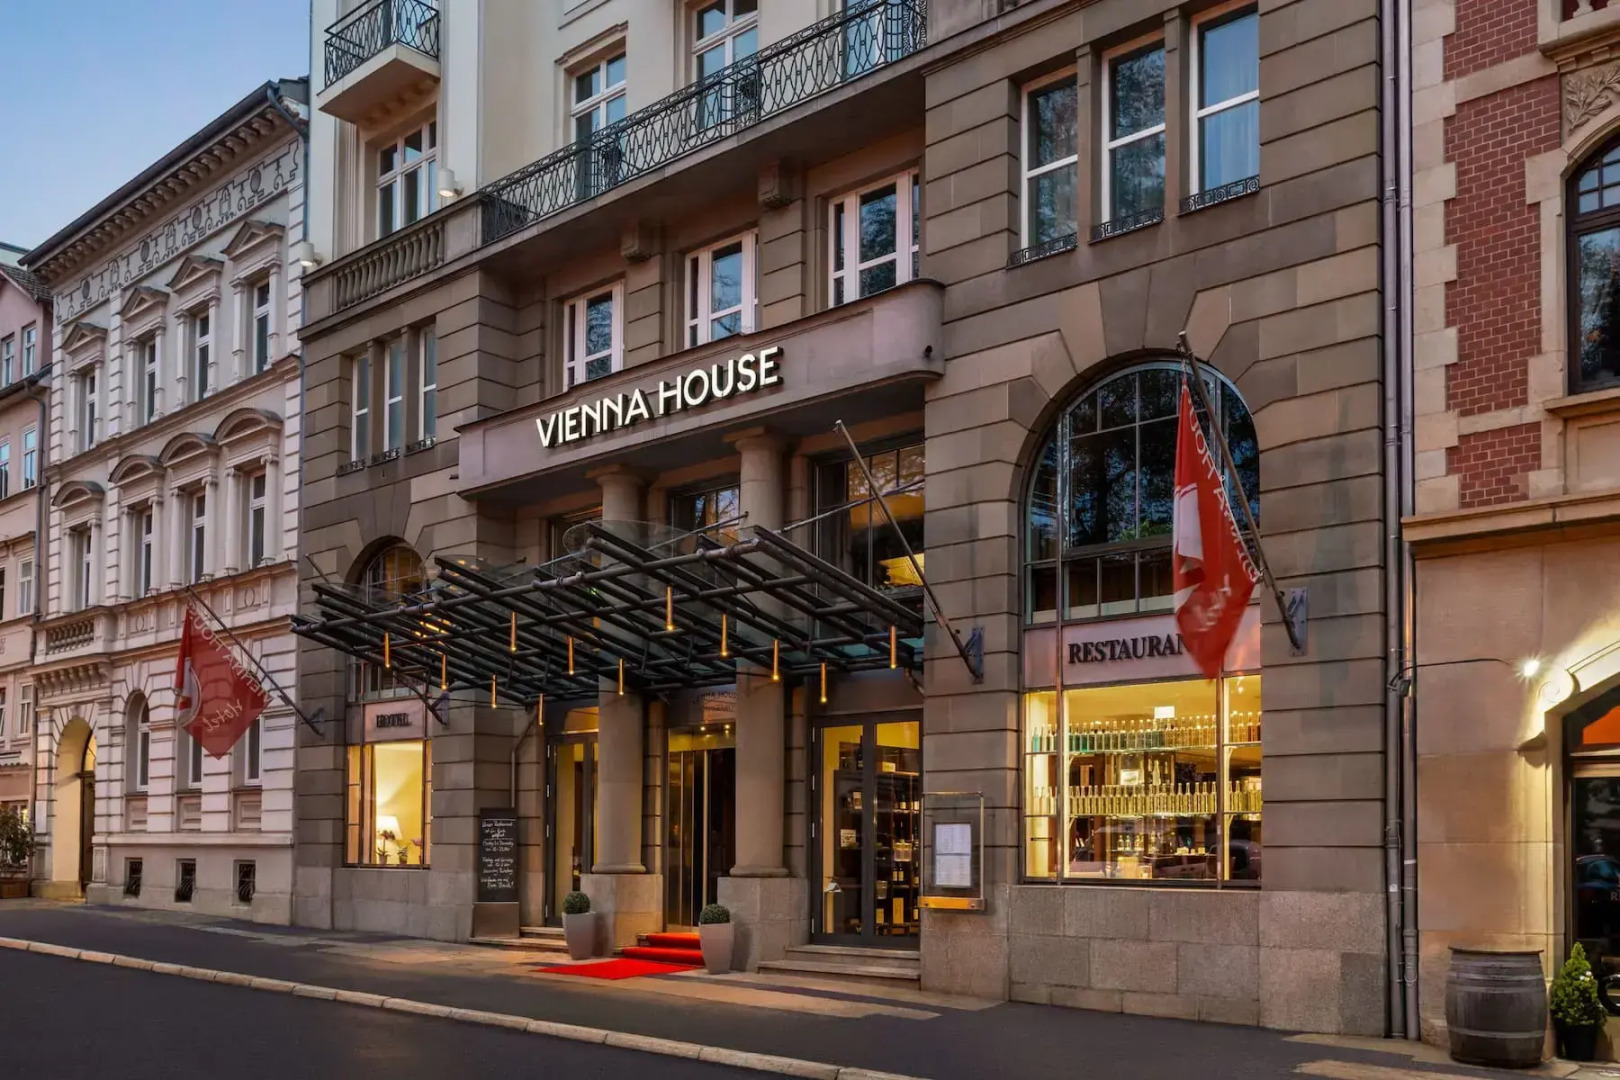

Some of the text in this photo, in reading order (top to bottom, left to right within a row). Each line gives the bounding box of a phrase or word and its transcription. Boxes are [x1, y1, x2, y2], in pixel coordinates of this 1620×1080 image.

[535, 345, 784, 449] VIENNA HOUSE
[1068, 633, 1191, 664] RESTAURAN
